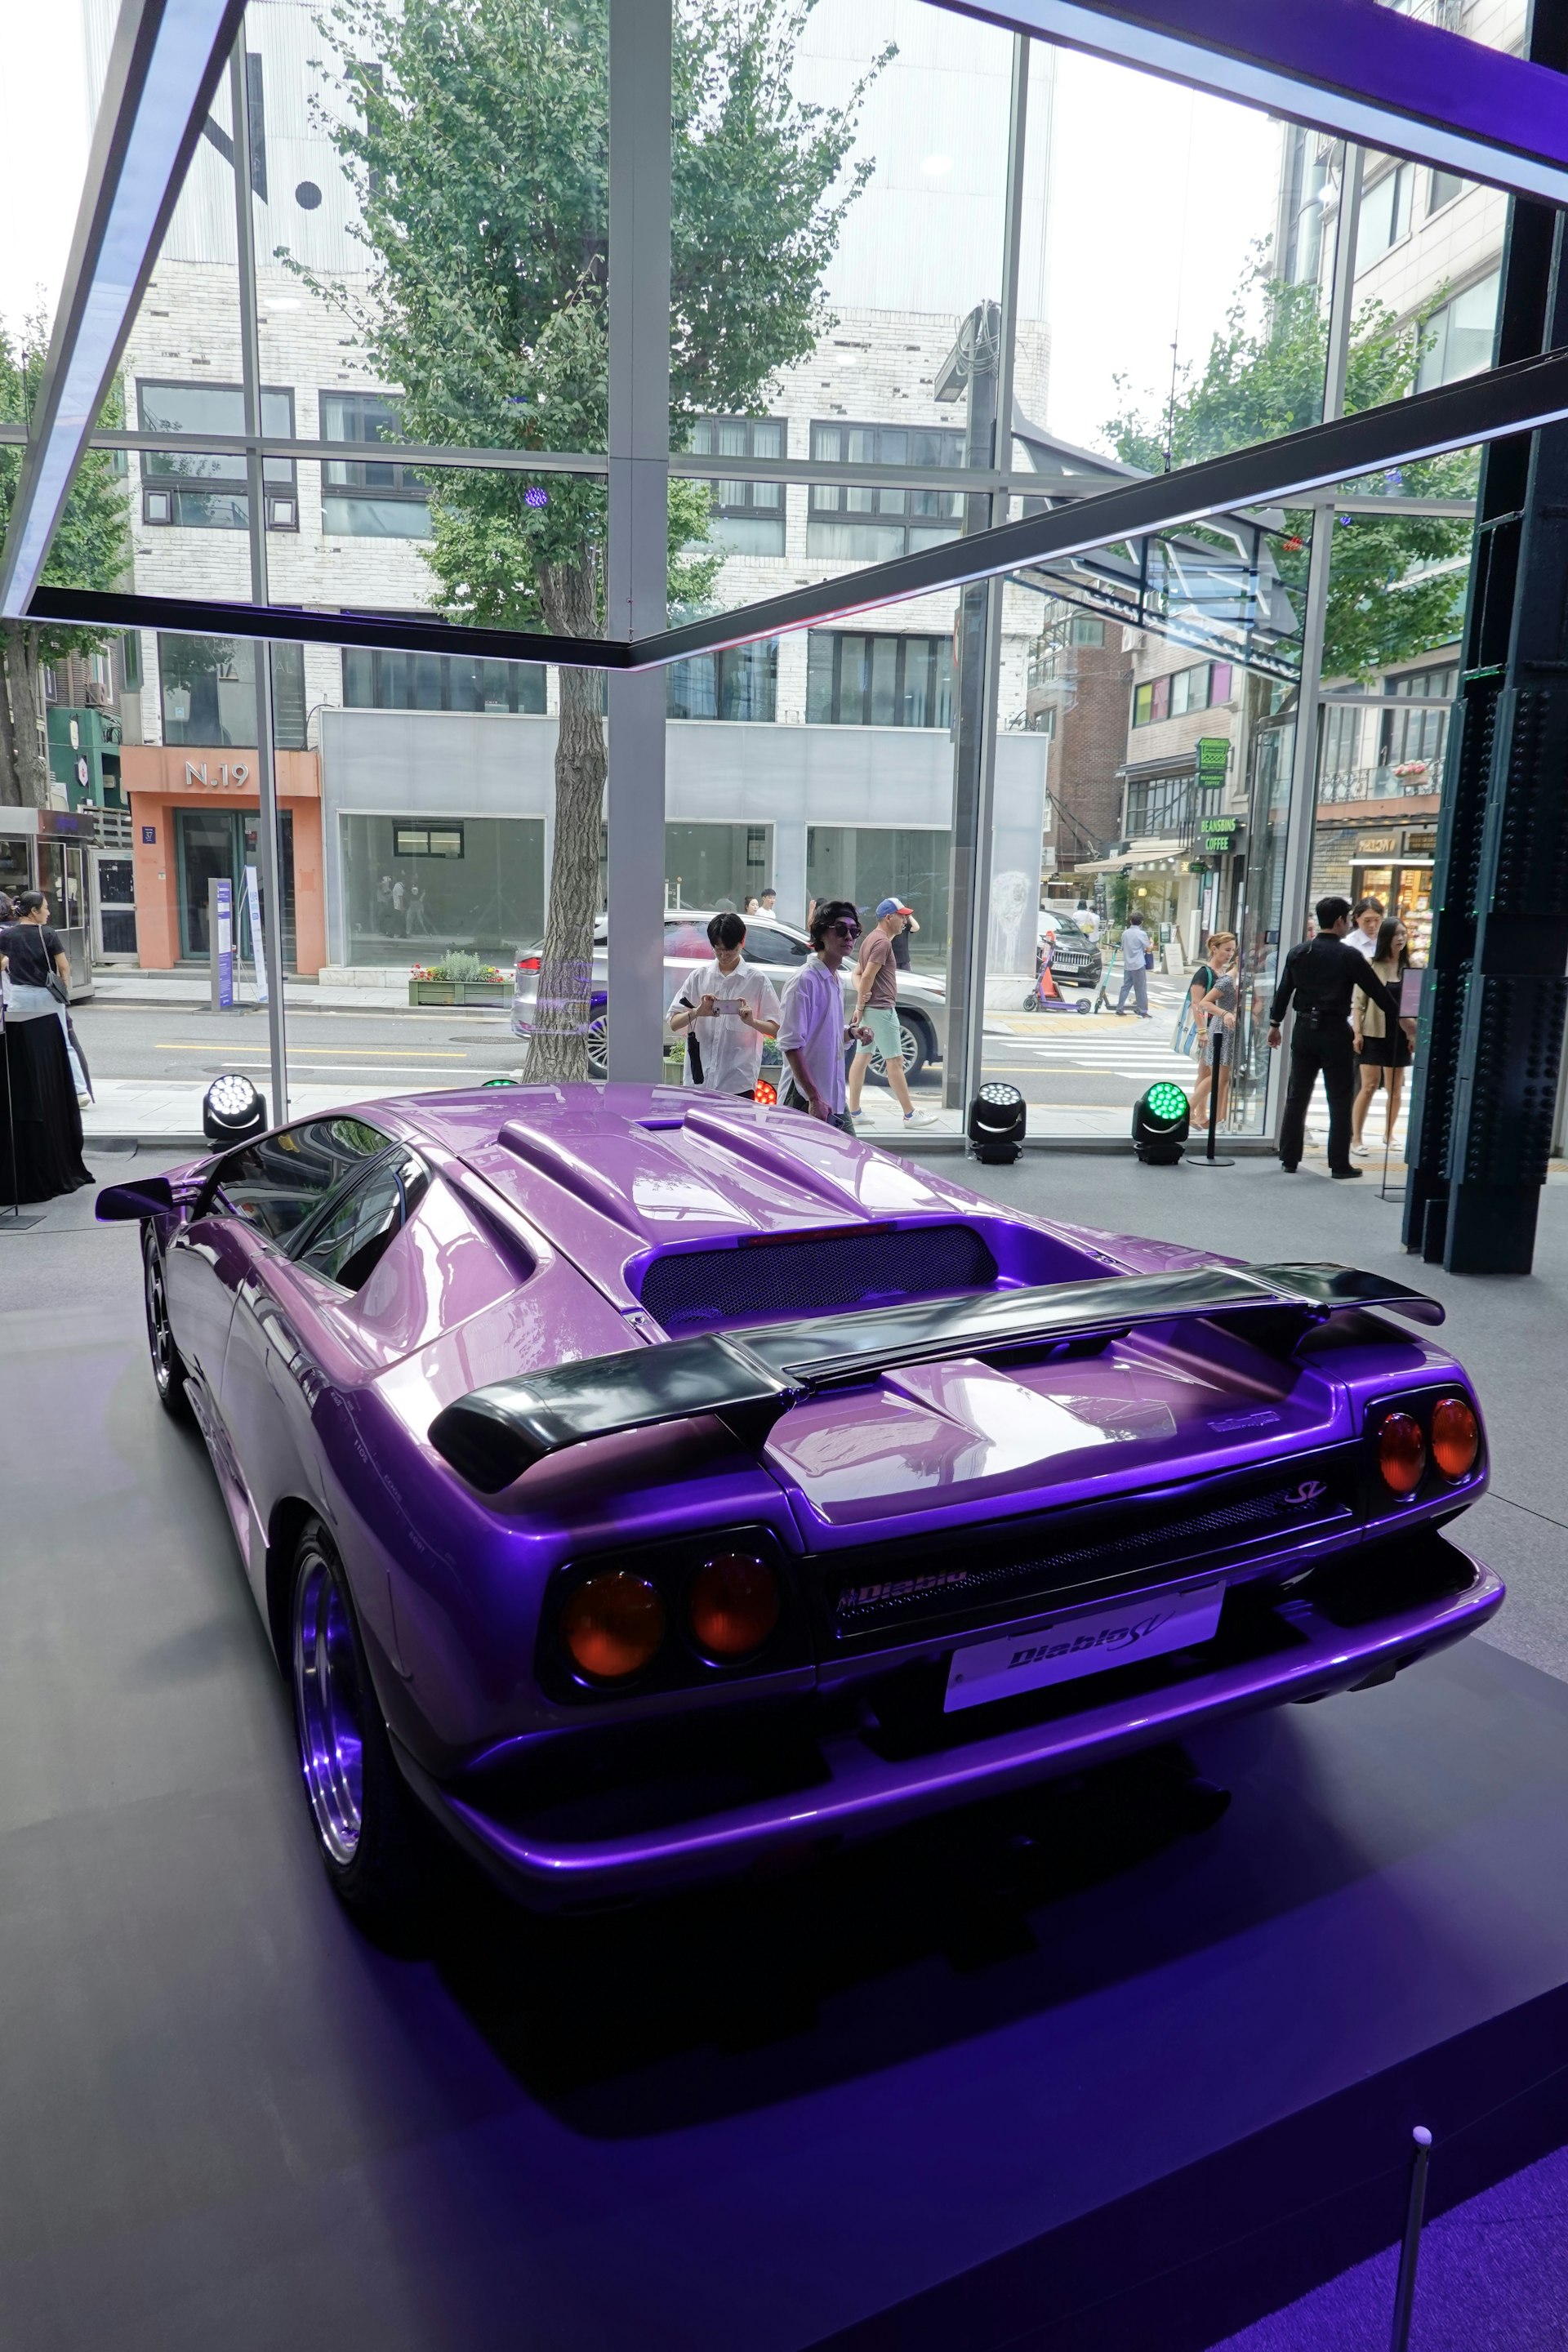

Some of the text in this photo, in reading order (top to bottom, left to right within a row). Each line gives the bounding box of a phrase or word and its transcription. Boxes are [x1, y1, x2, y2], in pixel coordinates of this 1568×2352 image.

[185, 760, 249, 786] N.19
[1200, 818, 1236, 833] BEANSBINS
[1205, 836, 1229, 851] COFFEE
[858, 1570, 968, 1606] Diablo
